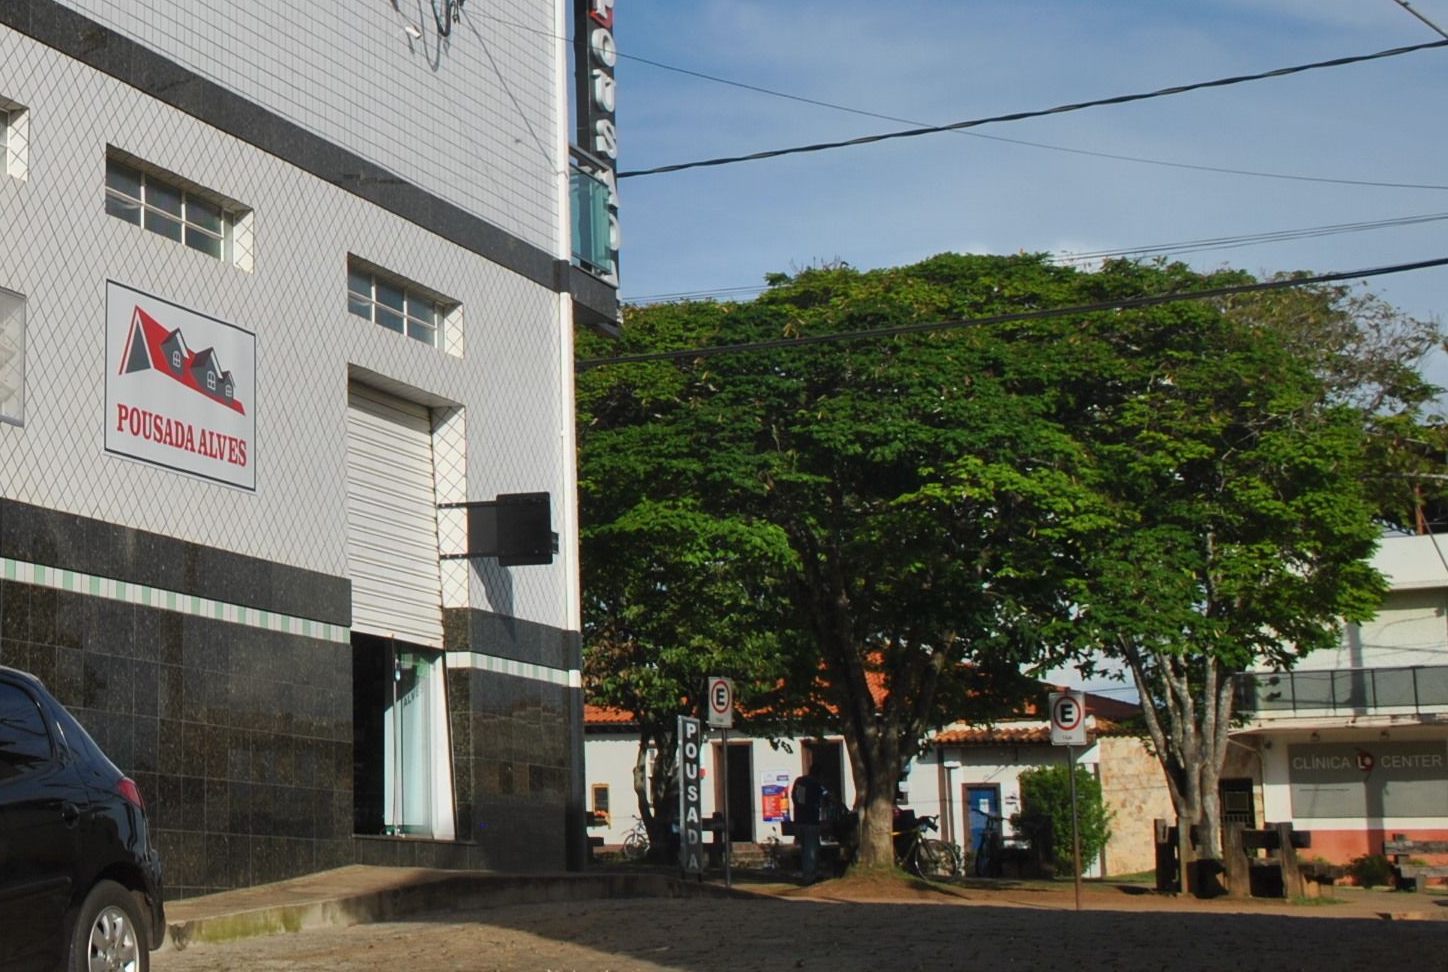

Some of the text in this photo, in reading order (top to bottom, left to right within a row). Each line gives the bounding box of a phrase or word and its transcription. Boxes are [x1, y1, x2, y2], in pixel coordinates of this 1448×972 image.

[116, 403, 248, 467] POUSADA ALVES
[716, 687, 726, 707] E
[1060, 703, 1074, 723] E
[1292, 754, 1352, 770] CLÍNICA
[1380, 754, 1444, 768] CENTER
[685, 722, 699, 870] POUSADA
